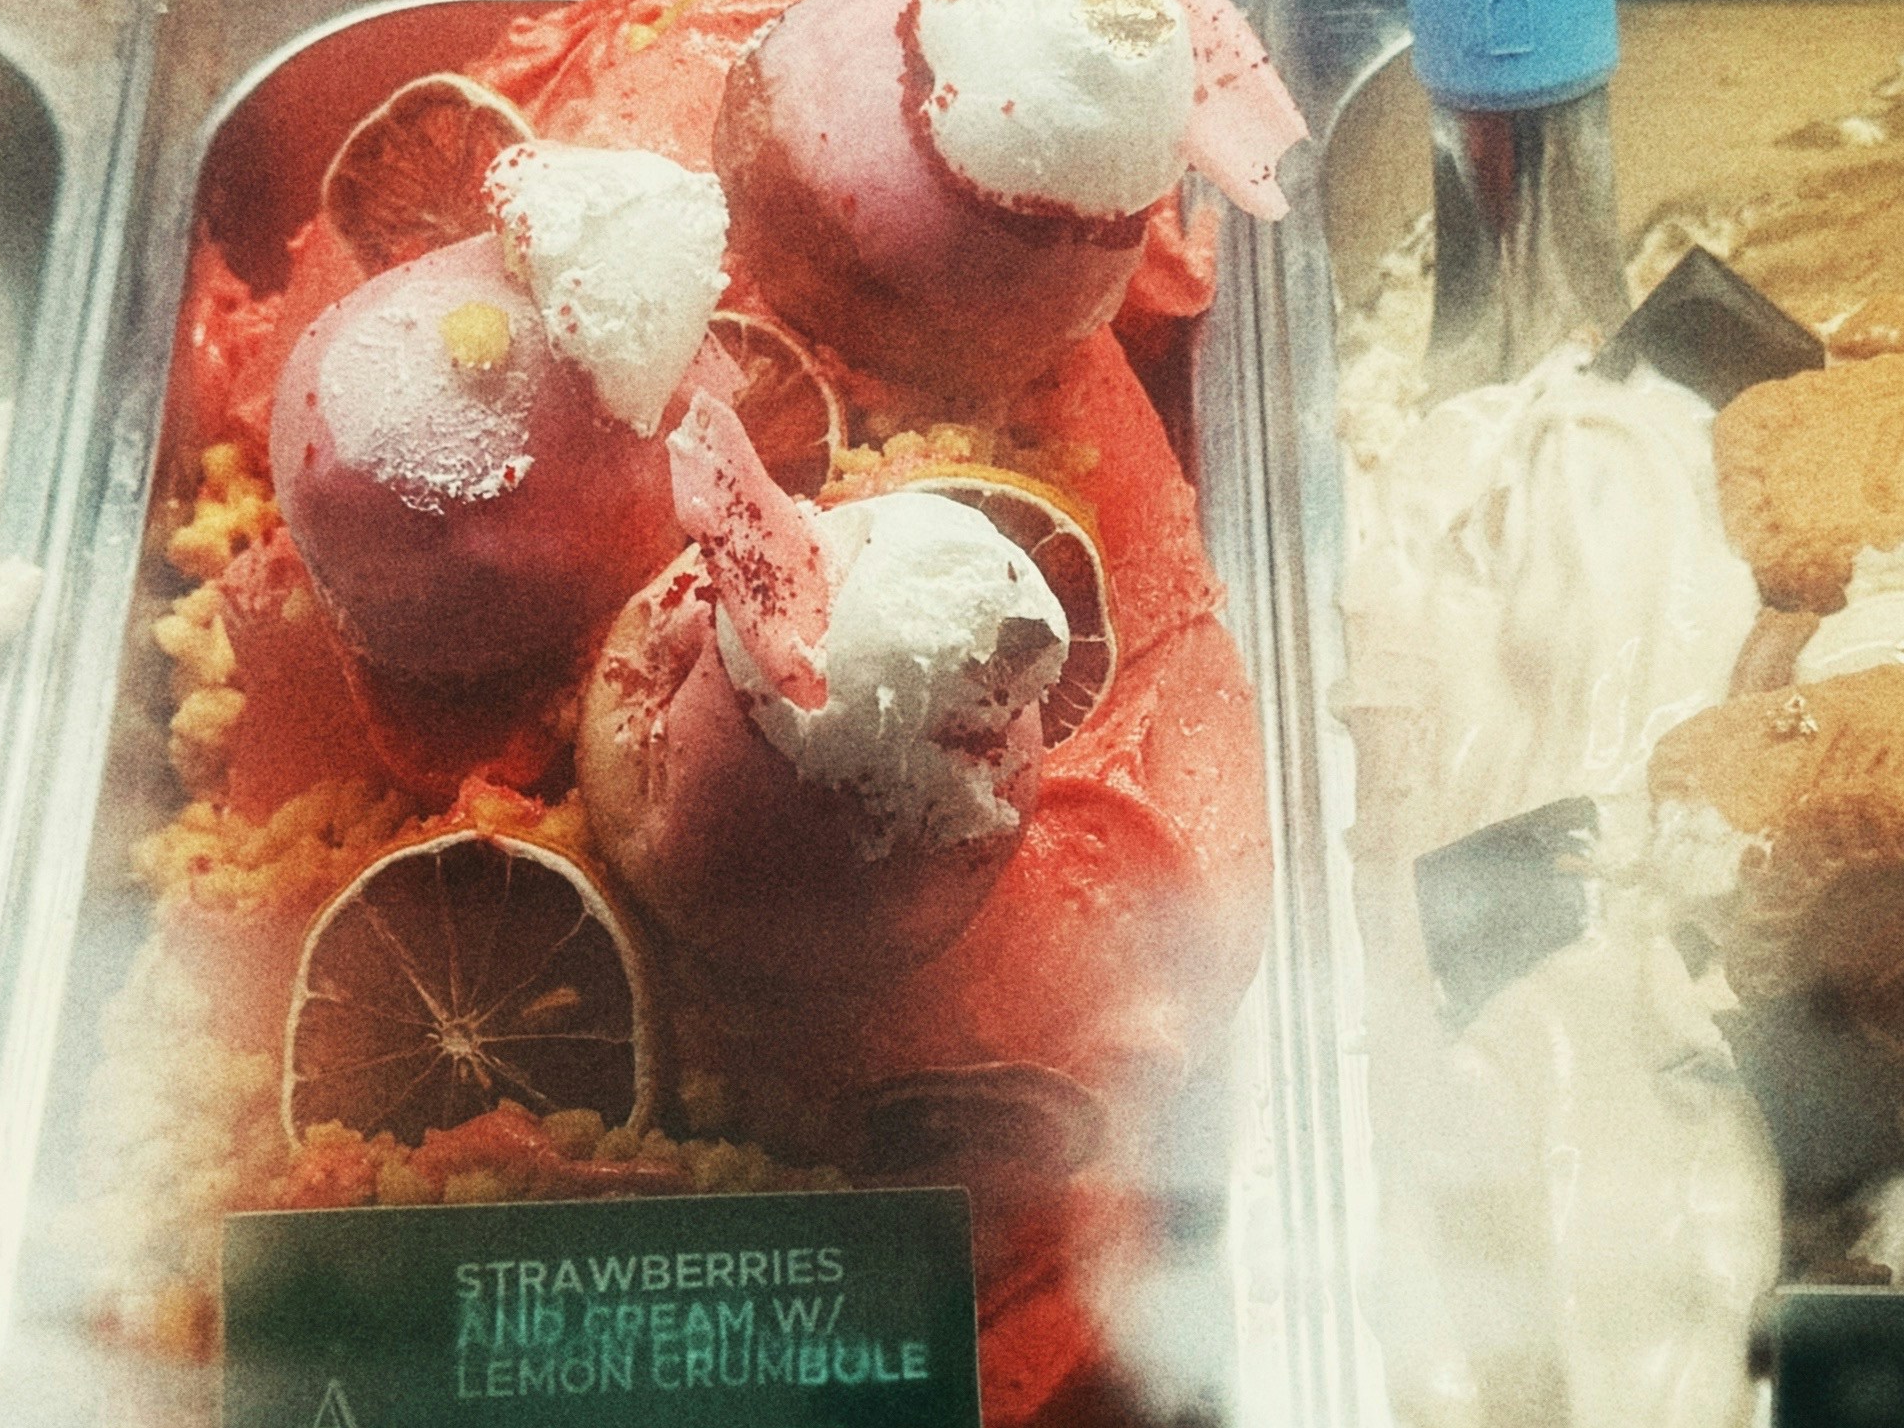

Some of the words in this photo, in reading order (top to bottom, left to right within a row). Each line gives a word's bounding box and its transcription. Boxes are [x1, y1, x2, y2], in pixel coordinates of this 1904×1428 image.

[455, 1247, 845, 1299] STRAWBERRIES
[585, 1299, 756, 1341] CREAM
[773, 1293, 846, 1335] W/
[456, 1349, 634, 1399] LEMON
